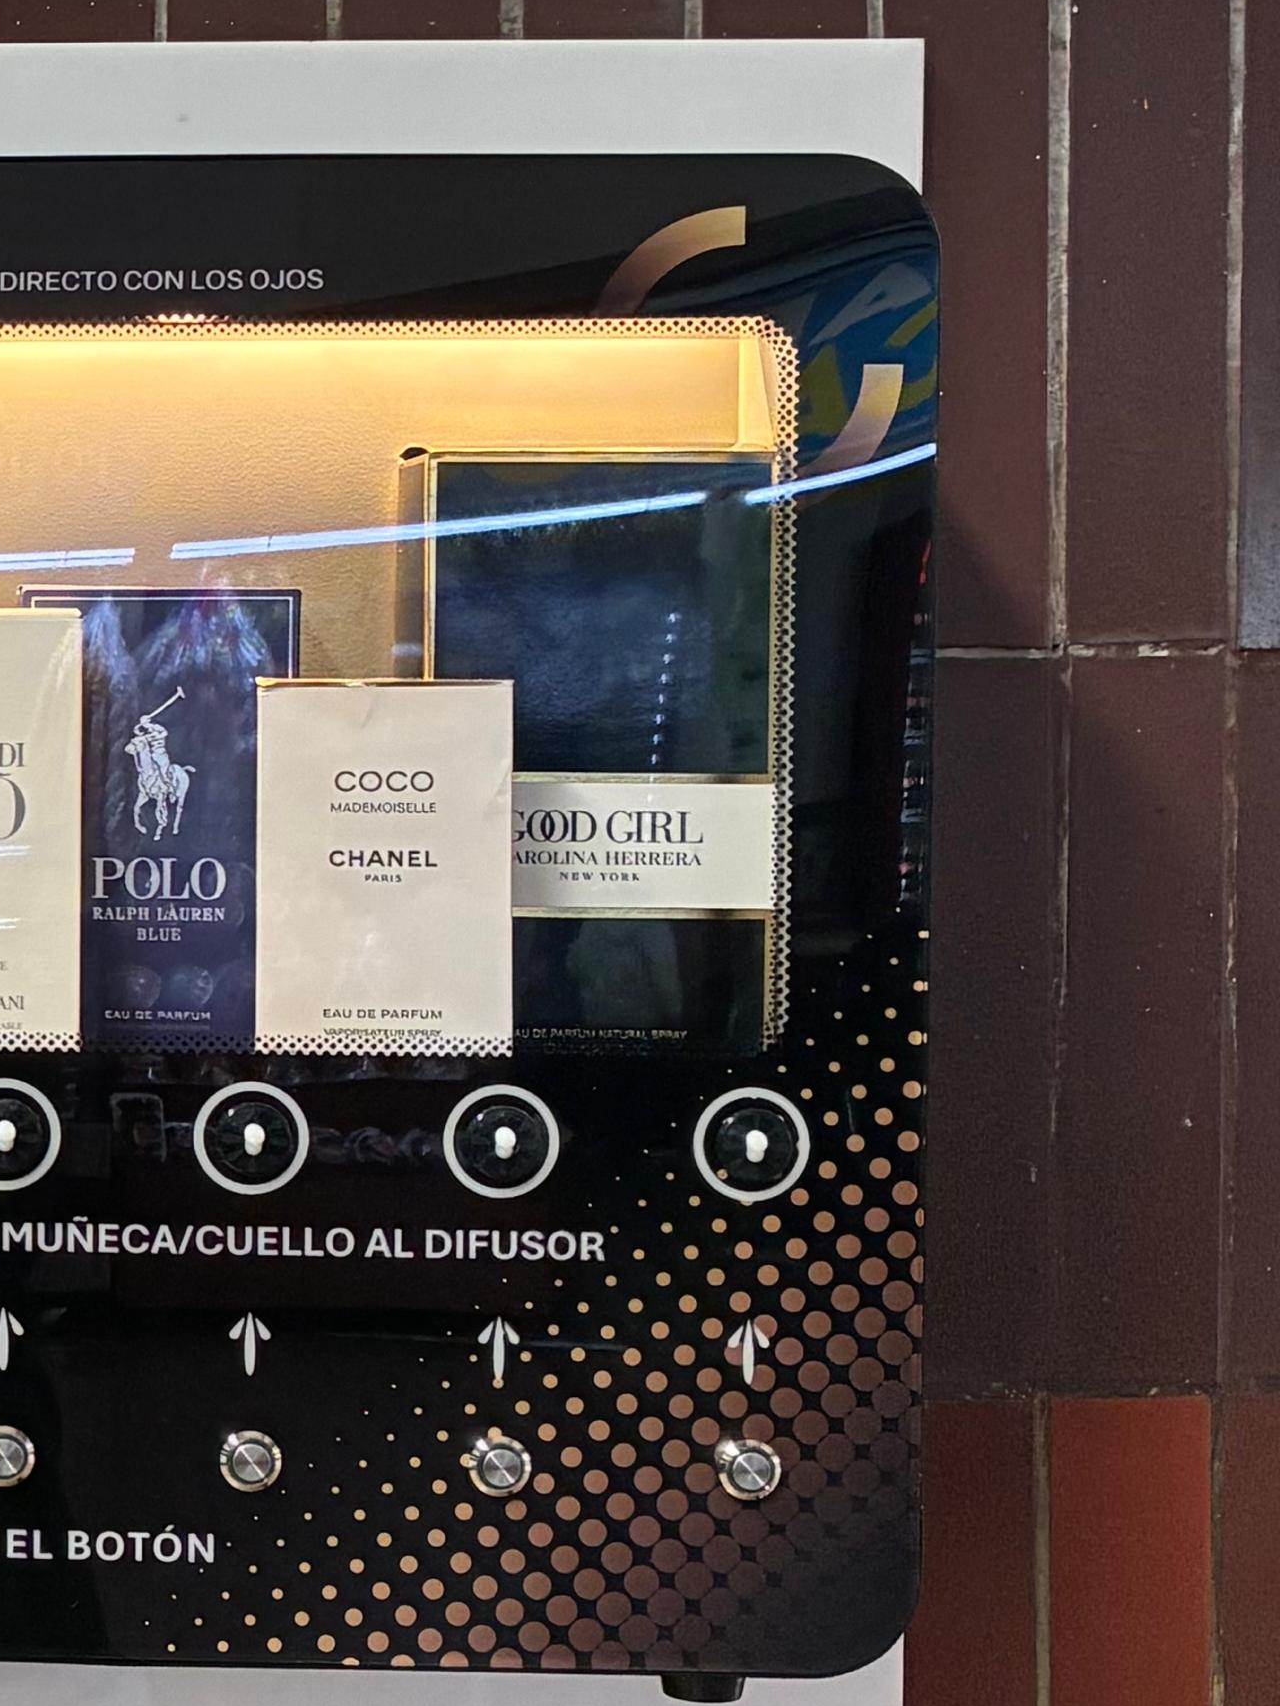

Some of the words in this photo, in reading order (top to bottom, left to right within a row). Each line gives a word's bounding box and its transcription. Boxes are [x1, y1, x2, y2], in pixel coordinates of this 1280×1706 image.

[0, 271, 116, 293] DIRECTO
[124, 269, 186, 291] CON
[192, 269, 243, 291] LOS
[250, 269, 324, 291] OJOS
[334, 769, 434, 793] COCO
[329, 801, 438, 814] MADEMOISELLE
[606, 809, 704, 844] GIRL
[328, 849, 438, 869] CHANEL
[512, 851, 598, 865] AROLINA
[606, 851, 702, 866] HERRERA
[92, 856, 226, 901] POLO
[364, 873, 402, 885] PARIS
[560, 871, 594, 881] NEW
[600, 871, 640, 881] YORK
[92, 906, 150, 921] RALPH
[157, 906, 226, 922] LAUREN
[136, 927, 182, 941] BLUE
[104, 1011, 130, 1019] EAU
[134, 1011, 153, 1019] DE
[157, 1011, 211, 1021] PARFUM
[322, 1009, 352, 1019] EAU
[356, 1009, 376, 1019] DE
[380, 1009, 443, 1019] PARFUM
[0, 1217, 355, 1259] MUÑECA/CUELLO
[364, 1229, 414, 1259] AL
[424, 1229, 606, 1263] DIFUSOR
[6, 1527, 52, 1561] EL
[66, 1525, 216, 1565] BOTÓN
